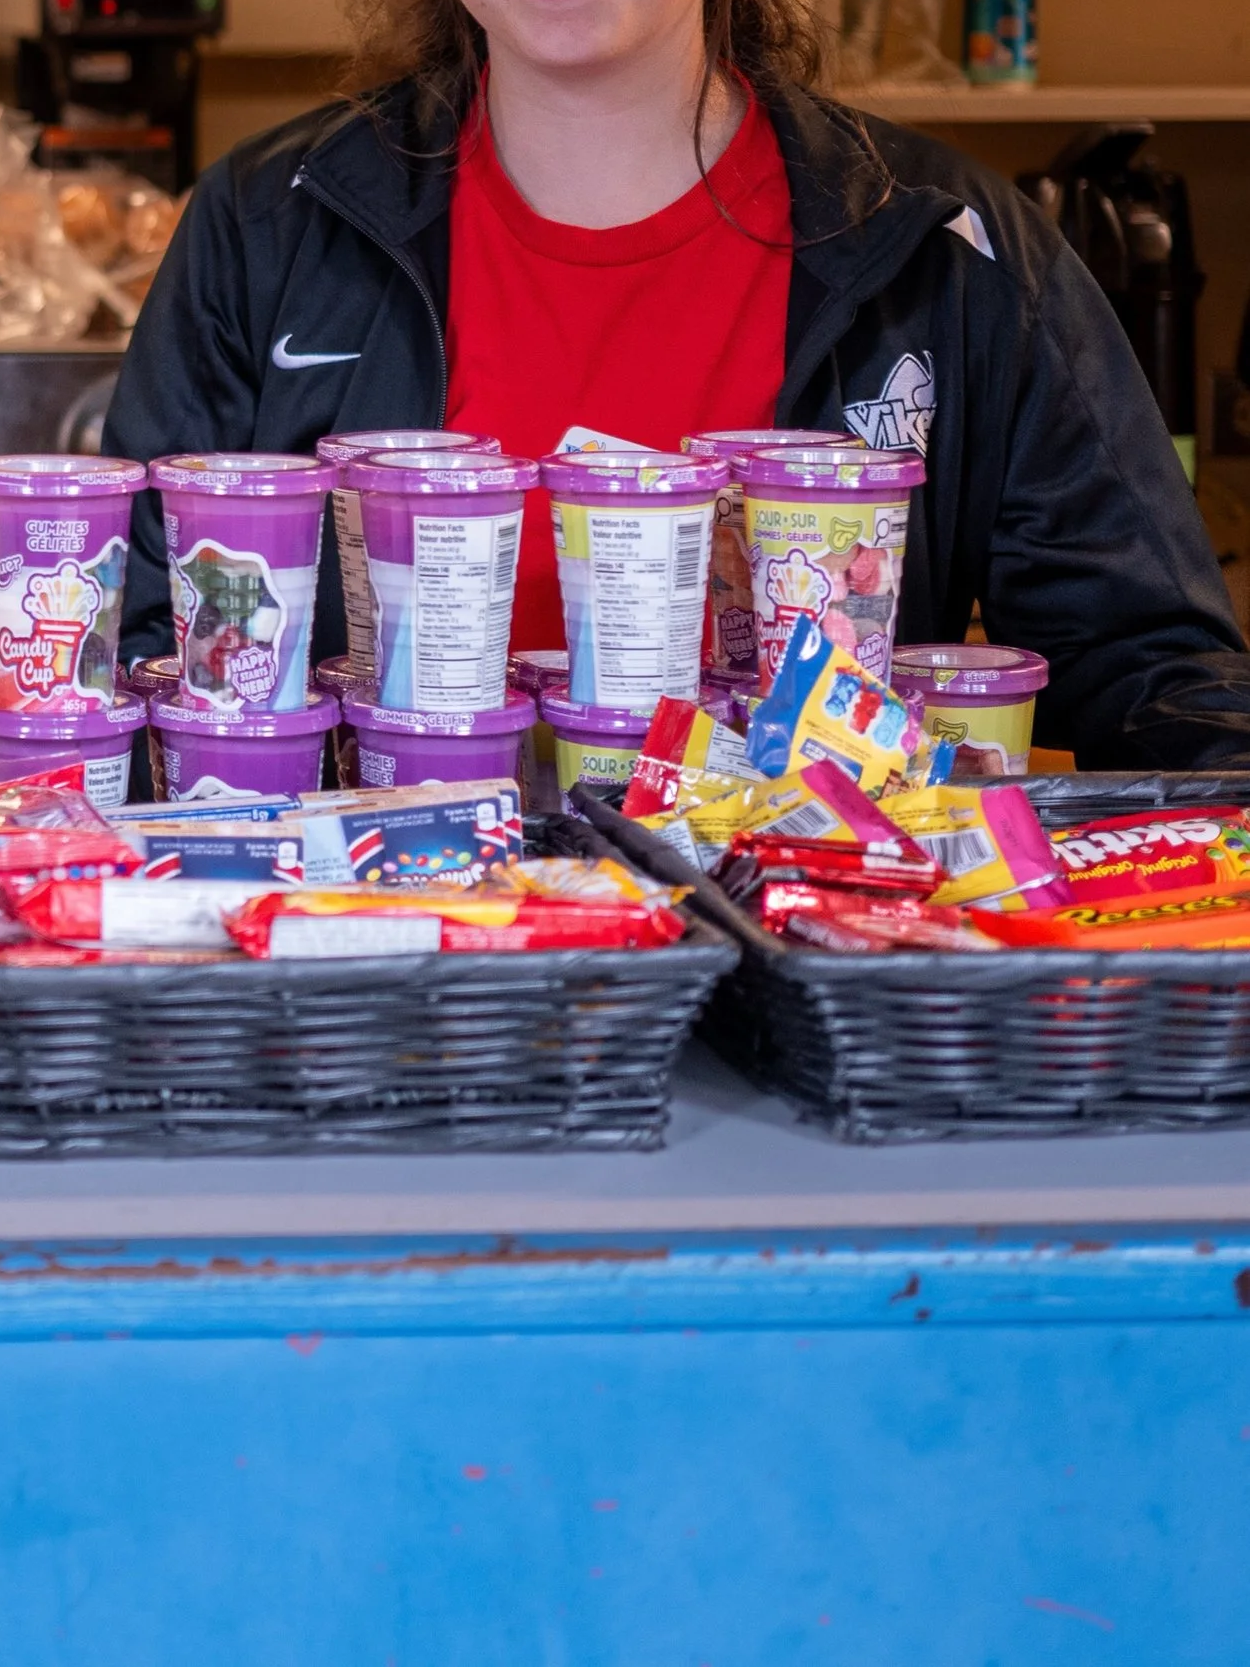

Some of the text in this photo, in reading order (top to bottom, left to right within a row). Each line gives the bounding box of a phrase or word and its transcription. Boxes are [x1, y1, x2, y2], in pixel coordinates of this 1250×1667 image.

[26, 521, 89, 535] GUMMIES
[592, 519, 640, 528] Nutrition Facts
[791, 512, 817, 528] SUR
[0, 633, 55, 665] Candy
[231, 651, 272, 672] HAPPY
[21, 659, 55, 691] Cup
[240, 668, 269, 682] STARTS
[240, 680, 272, 697] HERE
[372, 709, 420, 725] GUMMIES
[582, 756, 617, 774] SOUR
